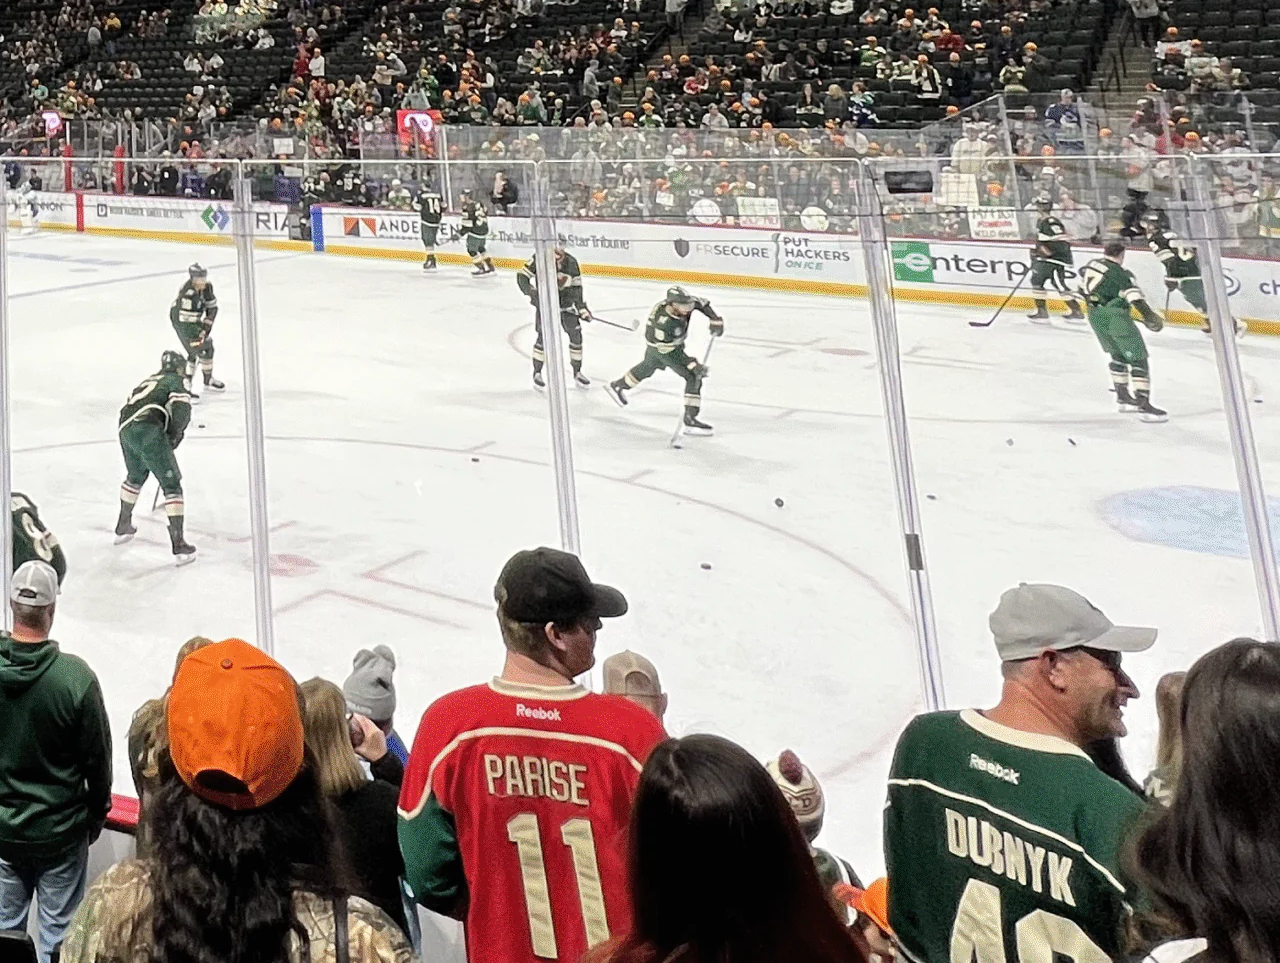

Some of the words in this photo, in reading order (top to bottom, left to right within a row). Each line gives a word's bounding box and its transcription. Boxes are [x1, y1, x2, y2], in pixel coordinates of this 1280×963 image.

[379, 218, 460, 236] ANDEEN
[783, 236, 810, 248] PUT
[696, 244, 770, 259] FRSECURE
[784, 247, 850, 262] HACKERS
[785, 260, 803, 269] ON
[803, 261, 823, 271] ICE
[516, 703, 562, 722] Reebok
[969, 752, 1020, 786] Reebok
[484, 753, 590, 807] PARISE
[945, 807, 1077, 907] DUBNYK
[507, 812, 612, 961] 11
